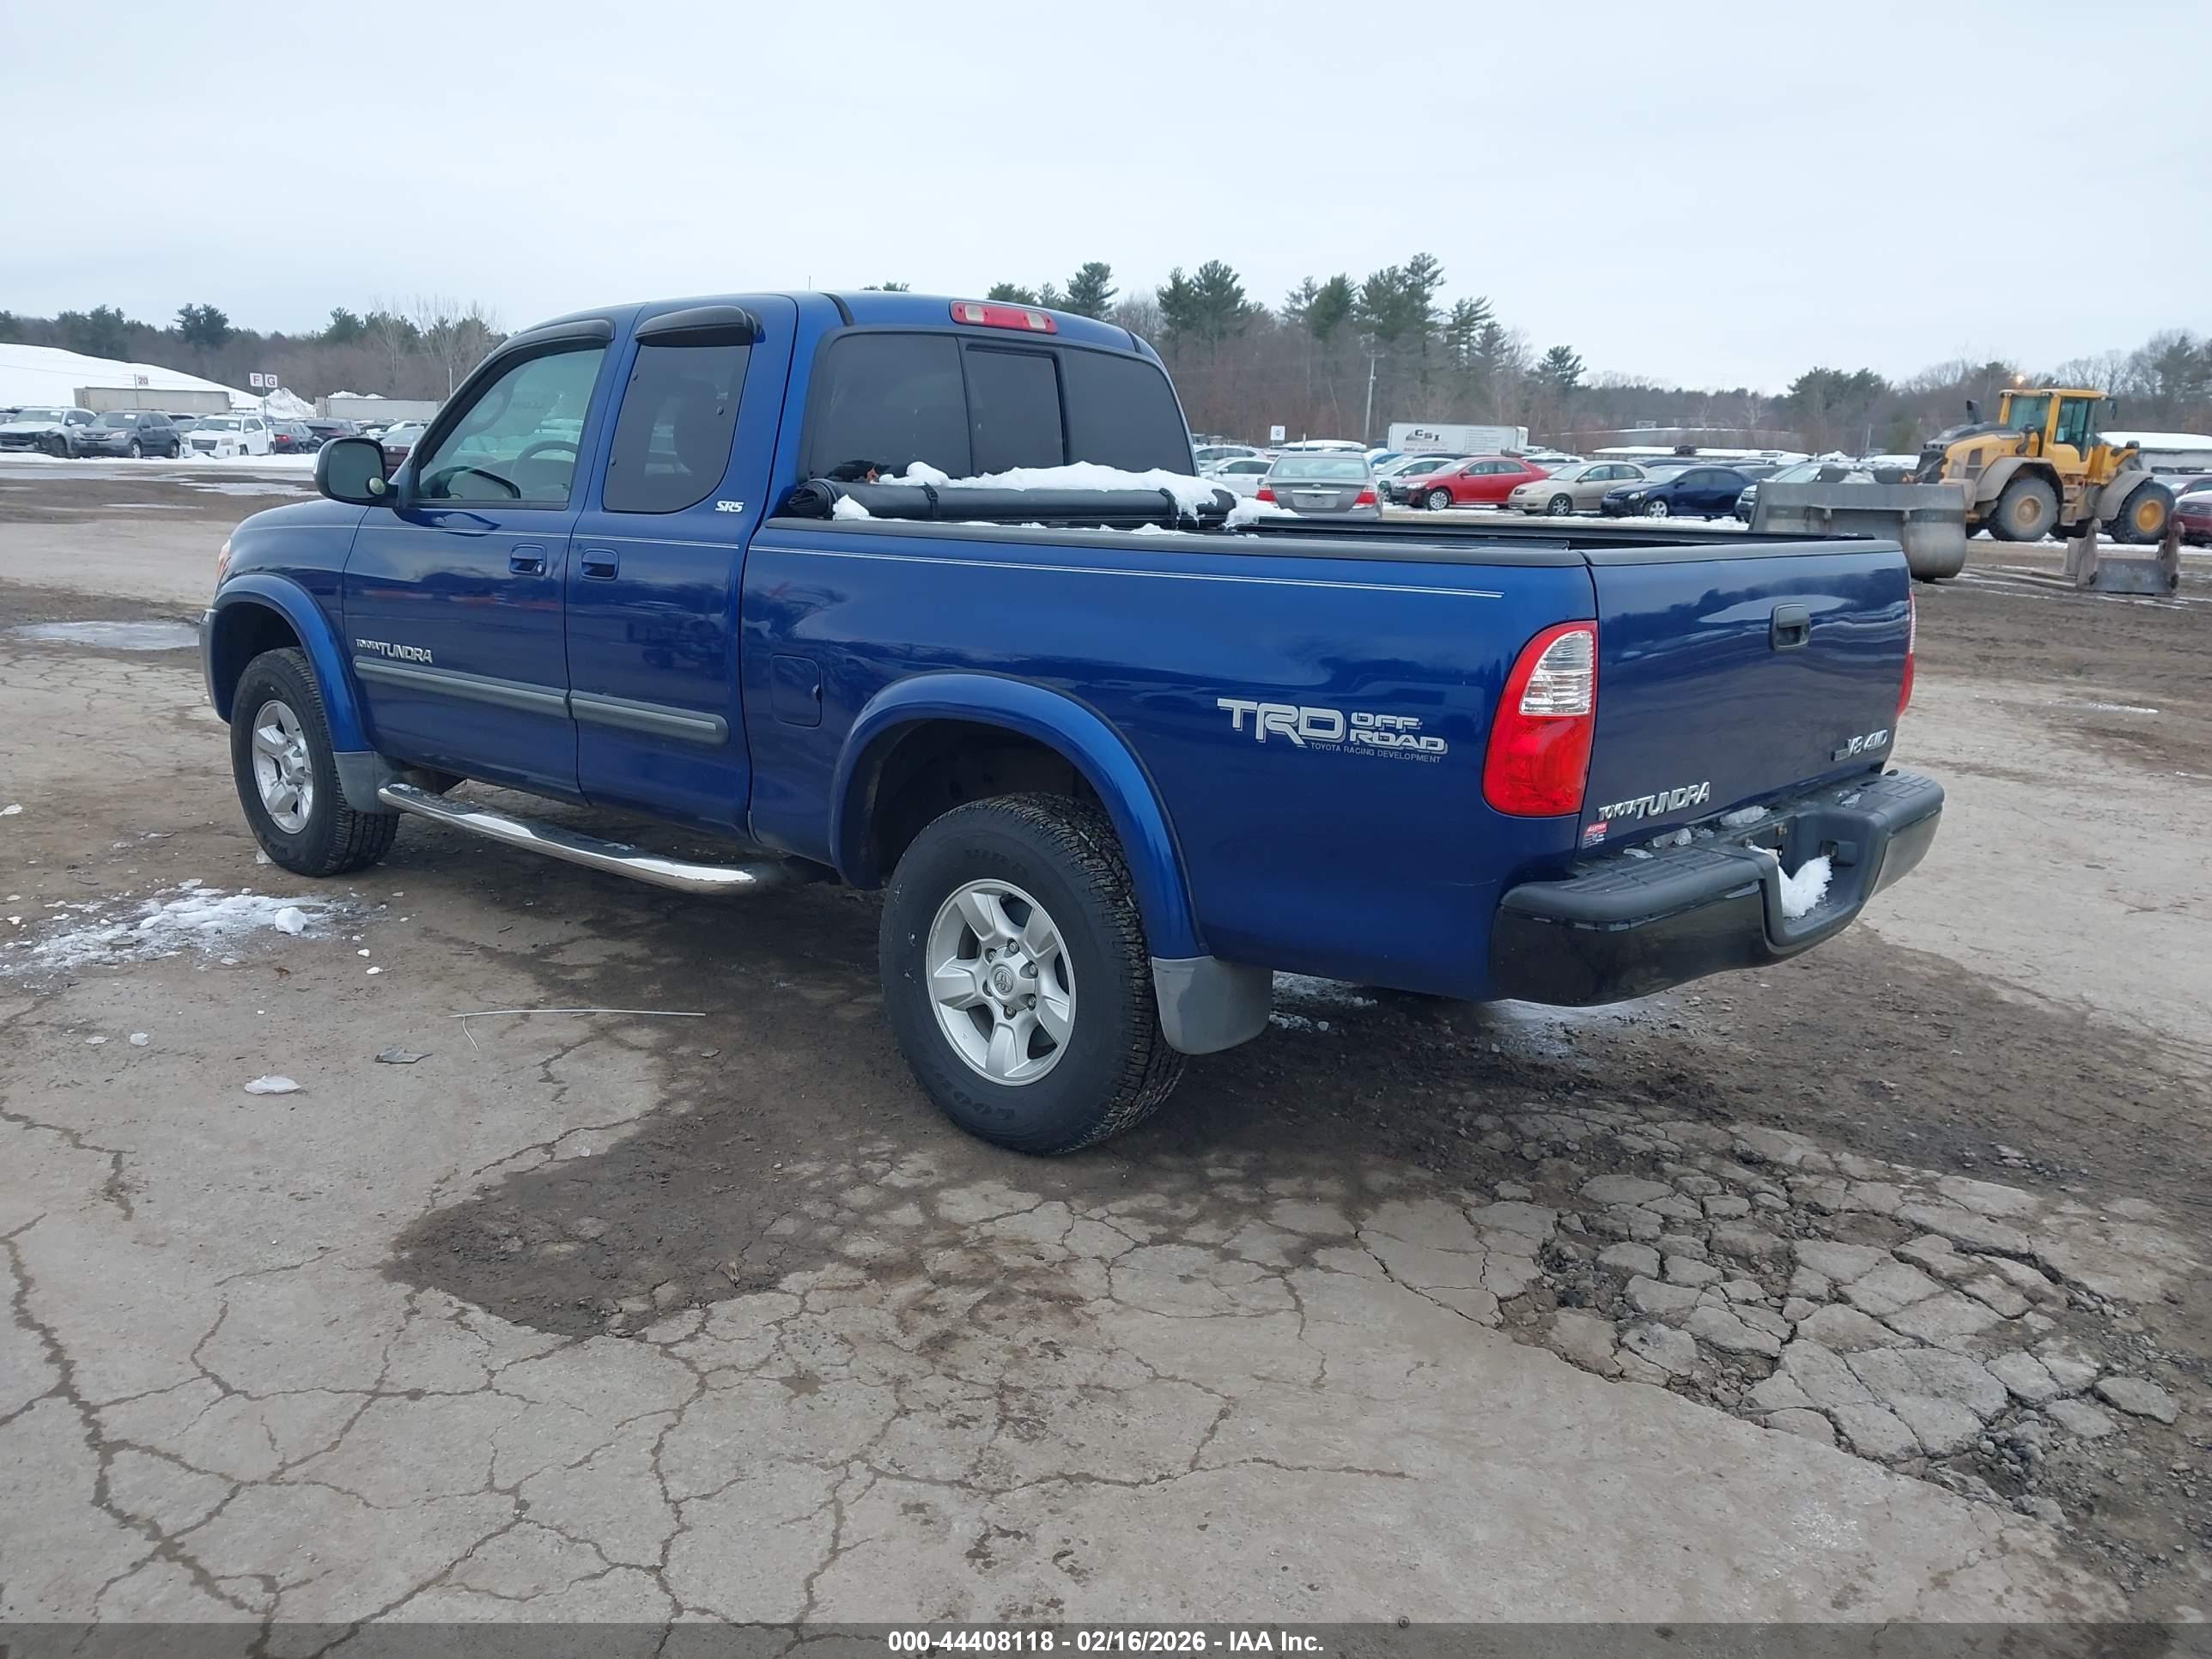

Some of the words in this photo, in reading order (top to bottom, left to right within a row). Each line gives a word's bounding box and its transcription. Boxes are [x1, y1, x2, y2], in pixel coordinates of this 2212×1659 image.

[138, 377, 149, 386] 20
[252, 374, 260, 385] F
[267, 375, 276, 386] G
[714, 500, 744, 513] SR5
[355, 638, 380, 651] TOYOTA
[378, 642, 433, 664] TUNDRA
[1216, 697, 1346, 749] TRD
[1351, 712, 1423, 732] OFF
[1310, 742, 1341, 752] TOYOTA
[1344, 745, 1375, 757] RACING
[1377, 750, 1441, 763] DEVELOPMENT
[1349, 729, 1449, 755] ROAD
[1847, 735, 1863, 757] V8
[1863, 729, 1888, 750] 4WD
[1598, 799, 1637, 821] TOYOTA
[1635, 781, 1711, 819] TUNDRA
